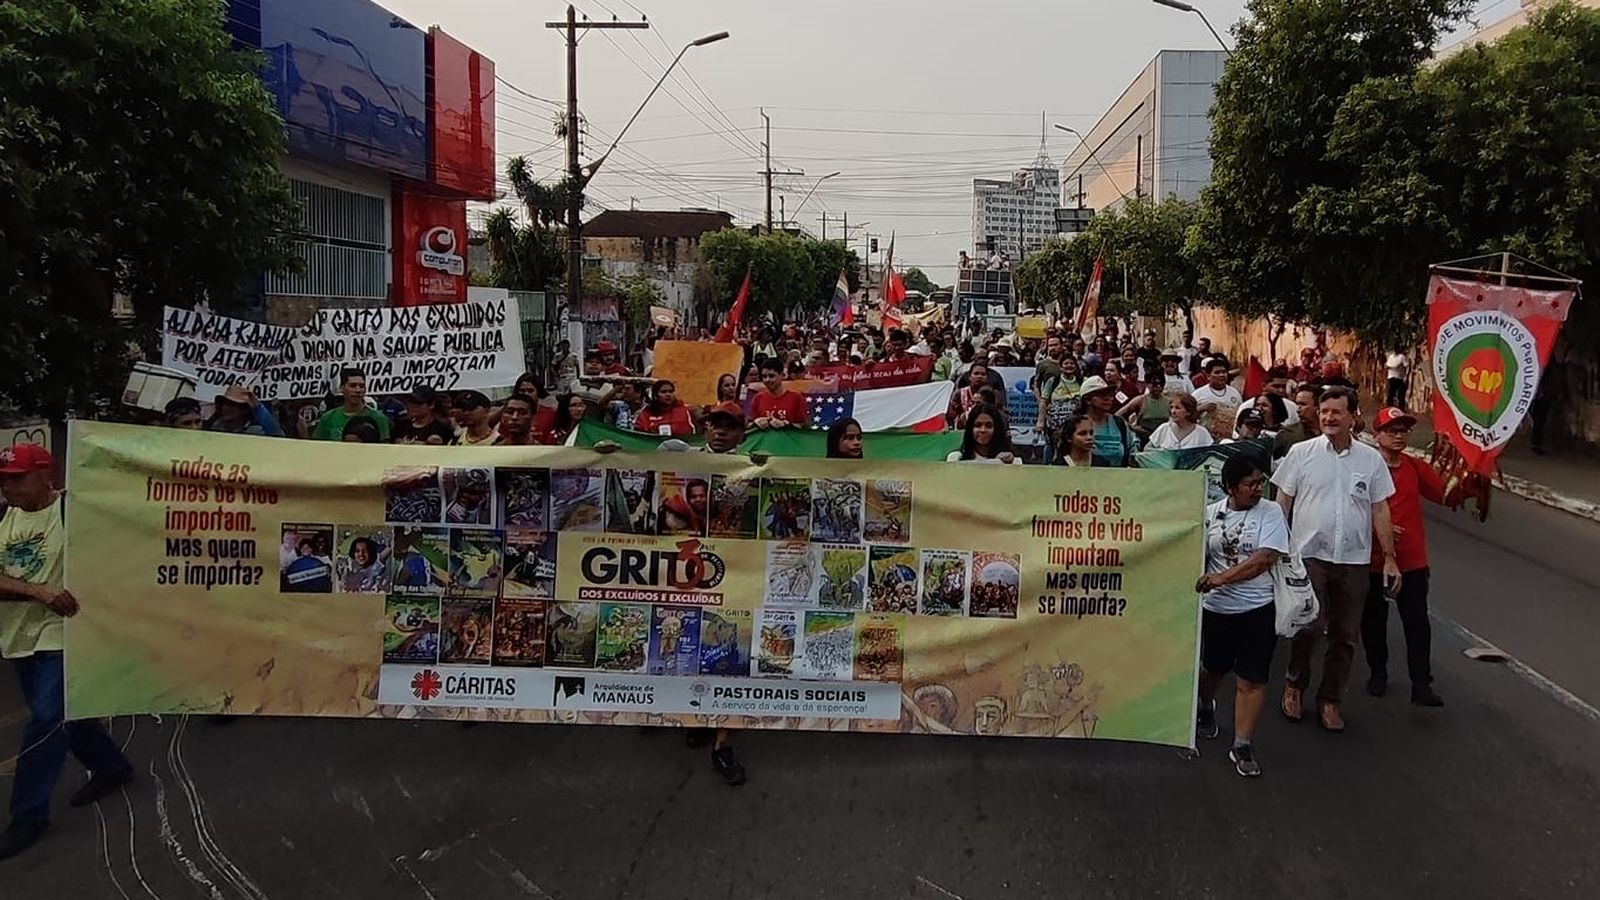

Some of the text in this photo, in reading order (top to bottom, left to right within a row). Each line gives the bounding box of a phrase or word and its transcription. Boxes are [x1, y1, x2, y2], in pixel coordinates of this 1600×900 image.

[331, 308, 383, 334] GRITO
[389, 306, 421, 334] DOS
[174, 339, 209, 365] POR
[301, 338, 346, 362] DIGNO
[353, 336, 377, 359] NA
[443, 328, 505, 354] PUBLICA
[261, 364, 322, 383] FORMAS
[356, 359, 393, 376] VIDA
[402, 353, 496, 376] IMPORTAM
[290, 381, 331, 398] QUEM
[146, 476, 208, 503] formas
[1053, 489, 1122, 516] Todas as
[165, 505, 256, 536] importam.
[1031, 514, 1144, 542] formas de vida
[165, 537, 256, 563] Mas quem
[1047, 541, 1124, 571] importam.
[157, 564, 179, 586] se
[184, 560, 264, 591] importa?
[580, 546, 726, 590] GRITO
[581, 588, 721, 604] DOS EXCLUÍDOS E EXCLUÍDAS
[1045, 571, 1123, 595] Mas quem
[1038, 591, 1127, 620] se importa?
[446, 672, 516, 696] CÁRITAS
[713, 686, 866, 702] PASTORAIS SOCIAIS
[593, 691, 655, 705] MANAUS
[712, 700, 719, 709] A
[758, 702, 769, 711] da
[771, 701, 791, 711] vida
